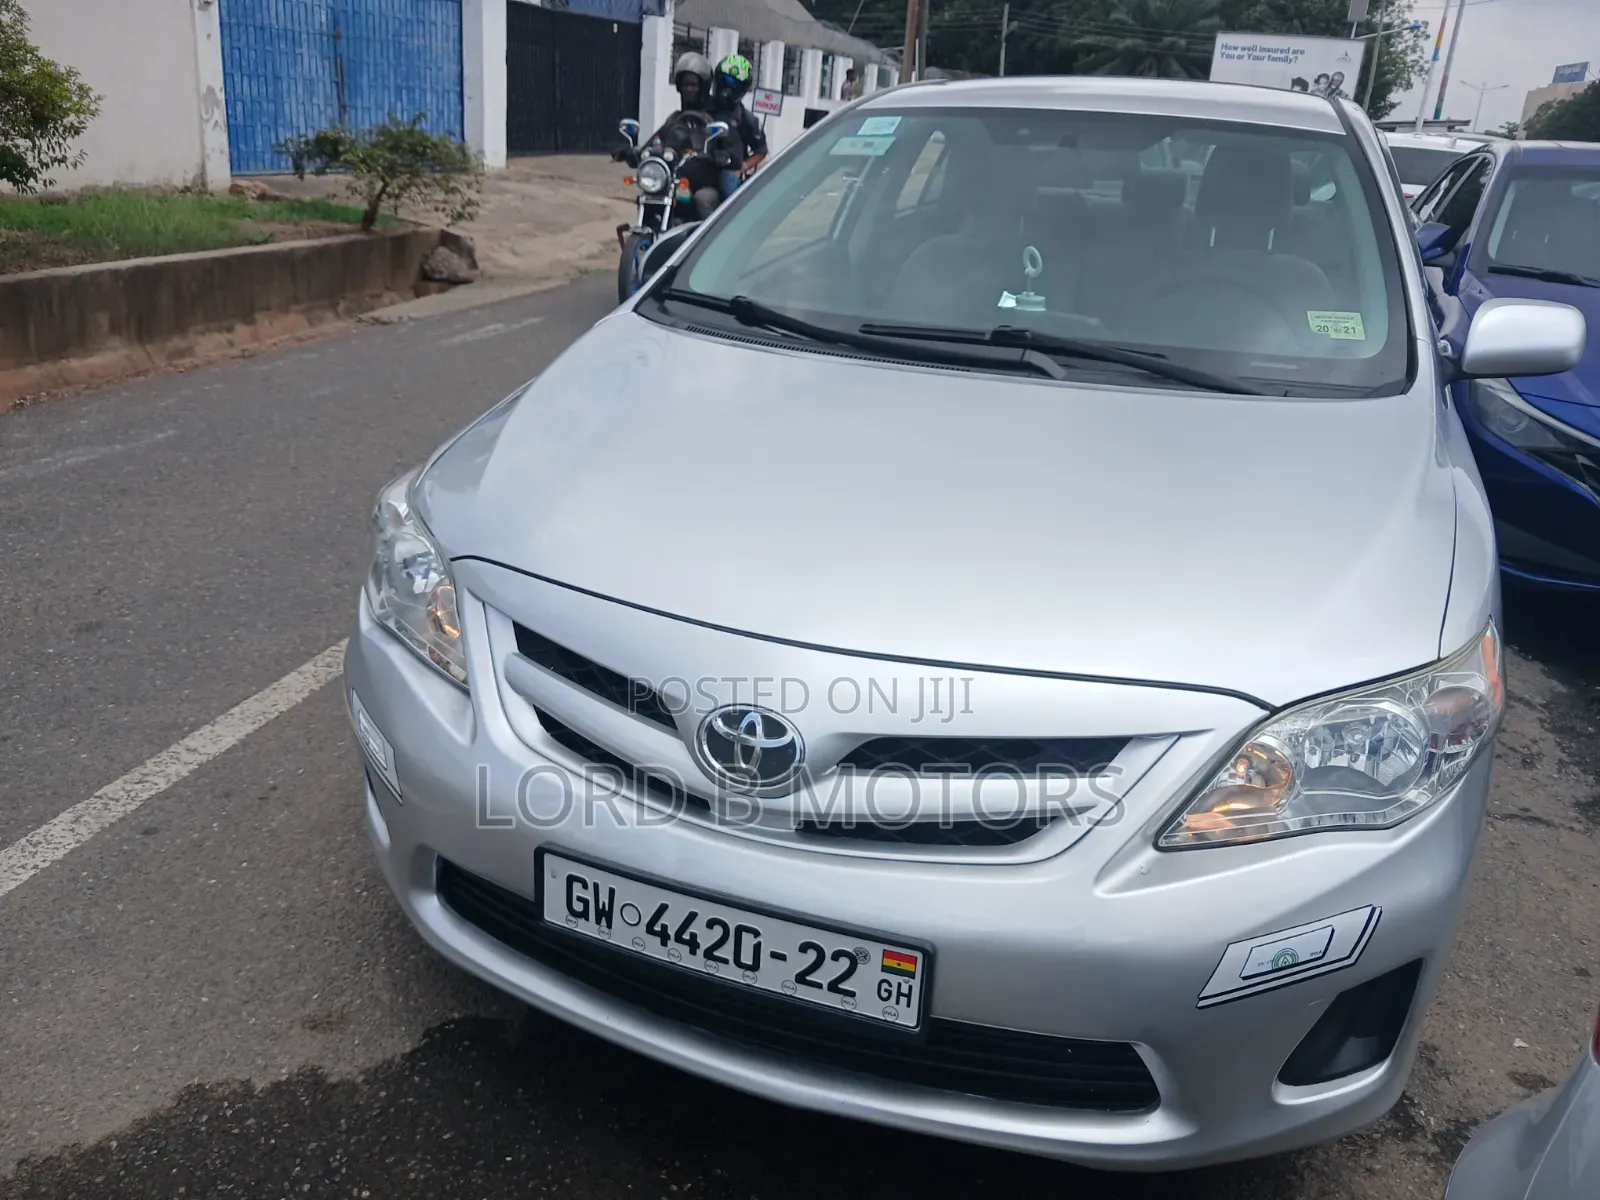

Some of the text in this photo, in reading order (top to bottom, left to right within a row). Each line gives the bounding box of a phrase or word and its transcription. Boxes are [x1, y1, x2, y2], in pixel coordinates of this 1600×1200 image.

[1221, 43, 1240, 51] How
[1240, 44, 1257, 52] well
[1259, 44, 1290, 54] insured
[1220, 51, 1235, 60] You
[1246, 52, 1266, 61] Your
[1267, 54, 1299, 64] family?
[1316, 324, 1356, 334] 20 21
[565, 873, 859, 999] GW 4420-22
[877, 978, 913, 1008] GH
